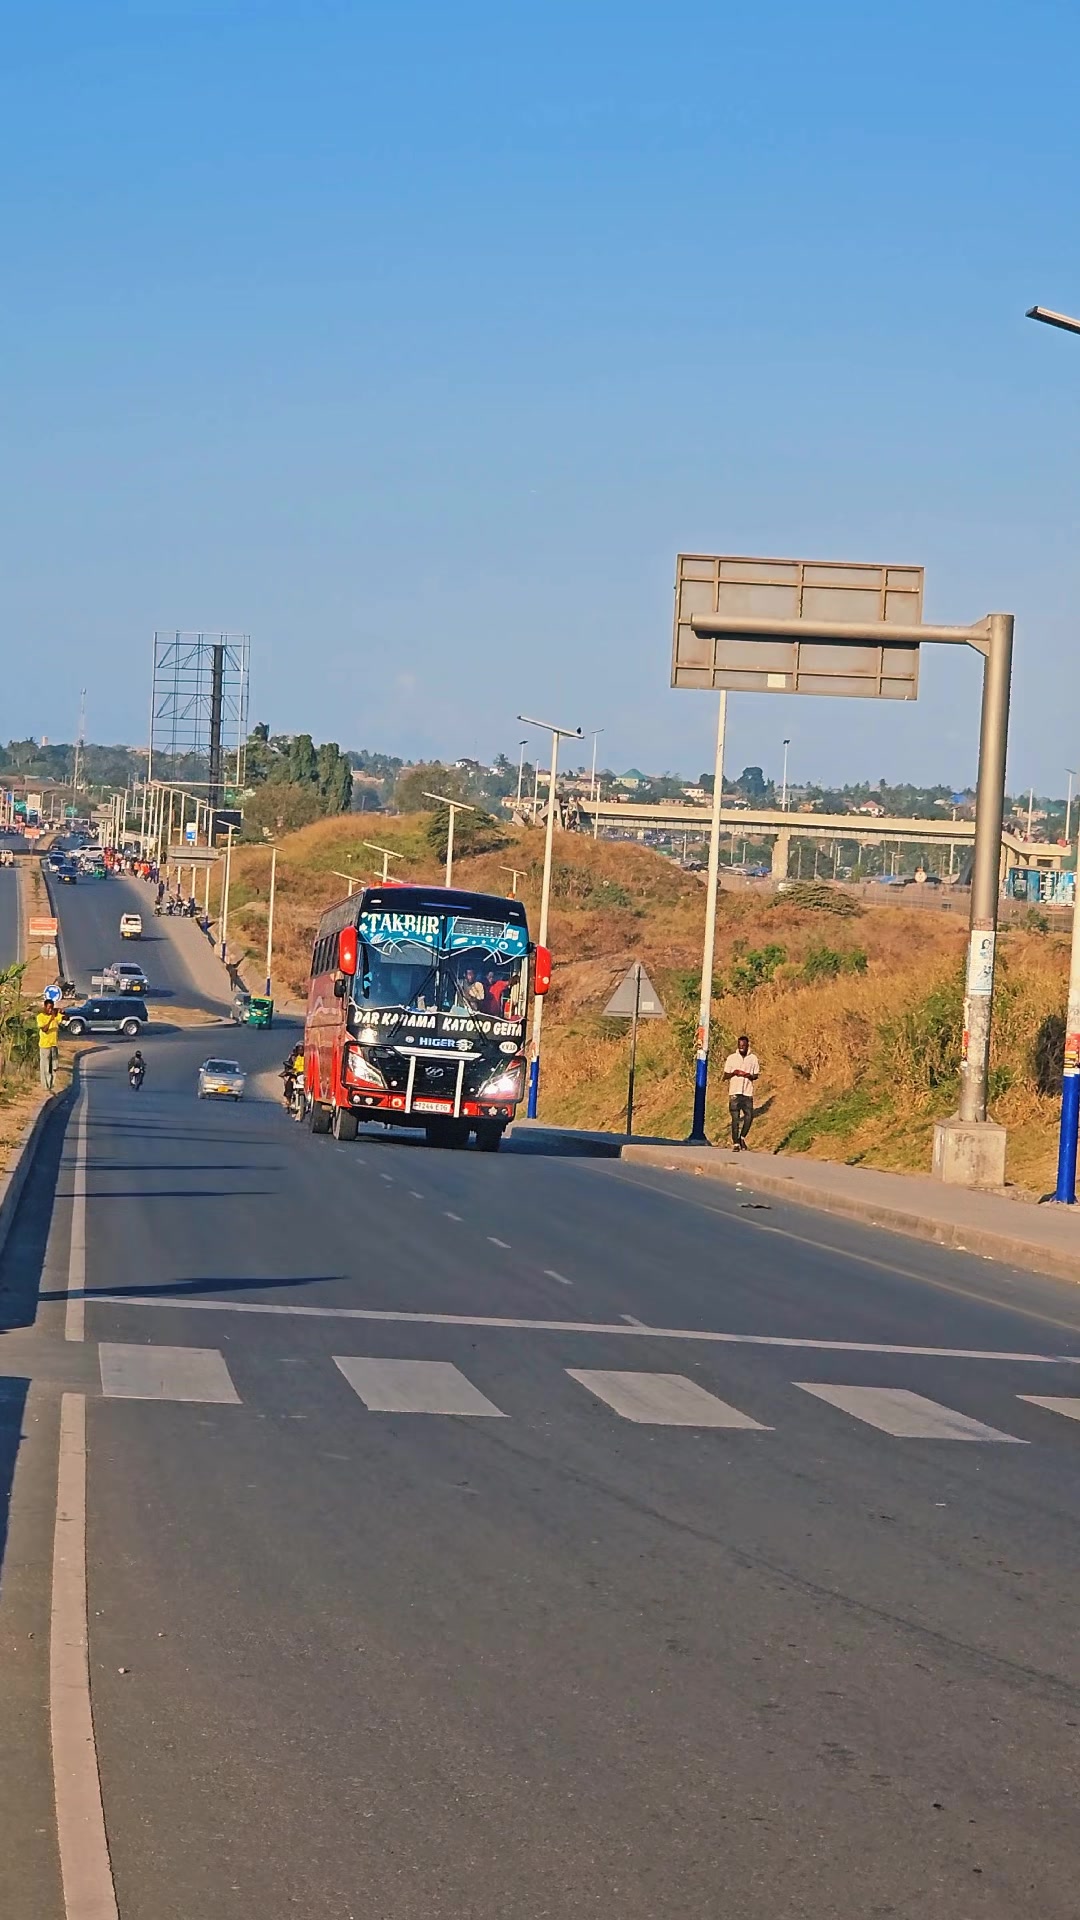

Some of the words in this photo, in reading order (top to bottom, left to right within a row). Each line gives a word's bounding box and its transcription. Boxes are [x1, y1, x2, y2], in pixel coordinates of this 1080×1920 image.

[367, 913, 439, 935] TAKBIIR
[353, 1011, 379, 1024] DAR
[493, 1022, 522, 1037] GEITA
[419, 1036, 455, 1047] HIGER
